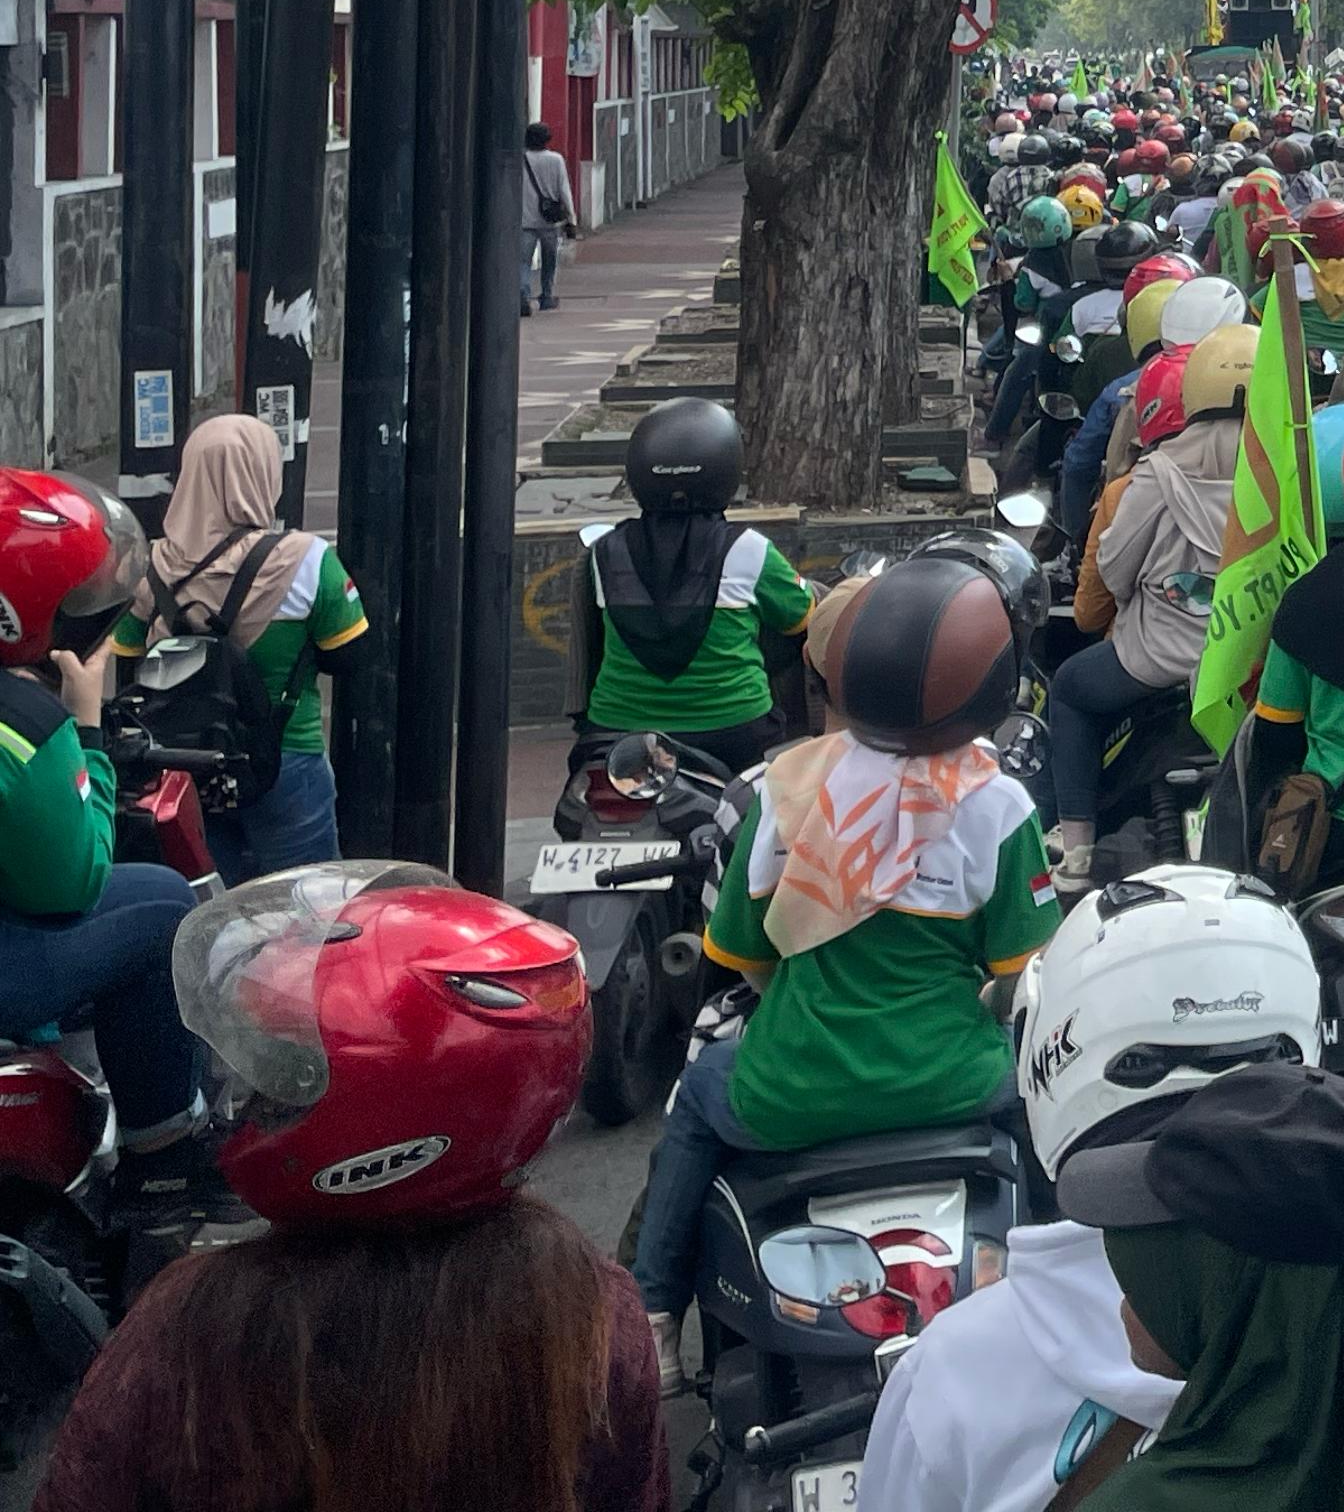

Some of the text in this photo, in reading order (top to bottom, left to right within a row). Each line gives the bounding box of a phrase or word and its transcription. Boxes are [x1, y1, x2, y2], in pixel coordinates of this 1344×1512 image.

[1321, 1019, 1338, 1046] W
[329, 1142, 425, 1188] INK
[870, 1212, 922, 1226] HONDA
[799, 1477, 820, 1512] W
